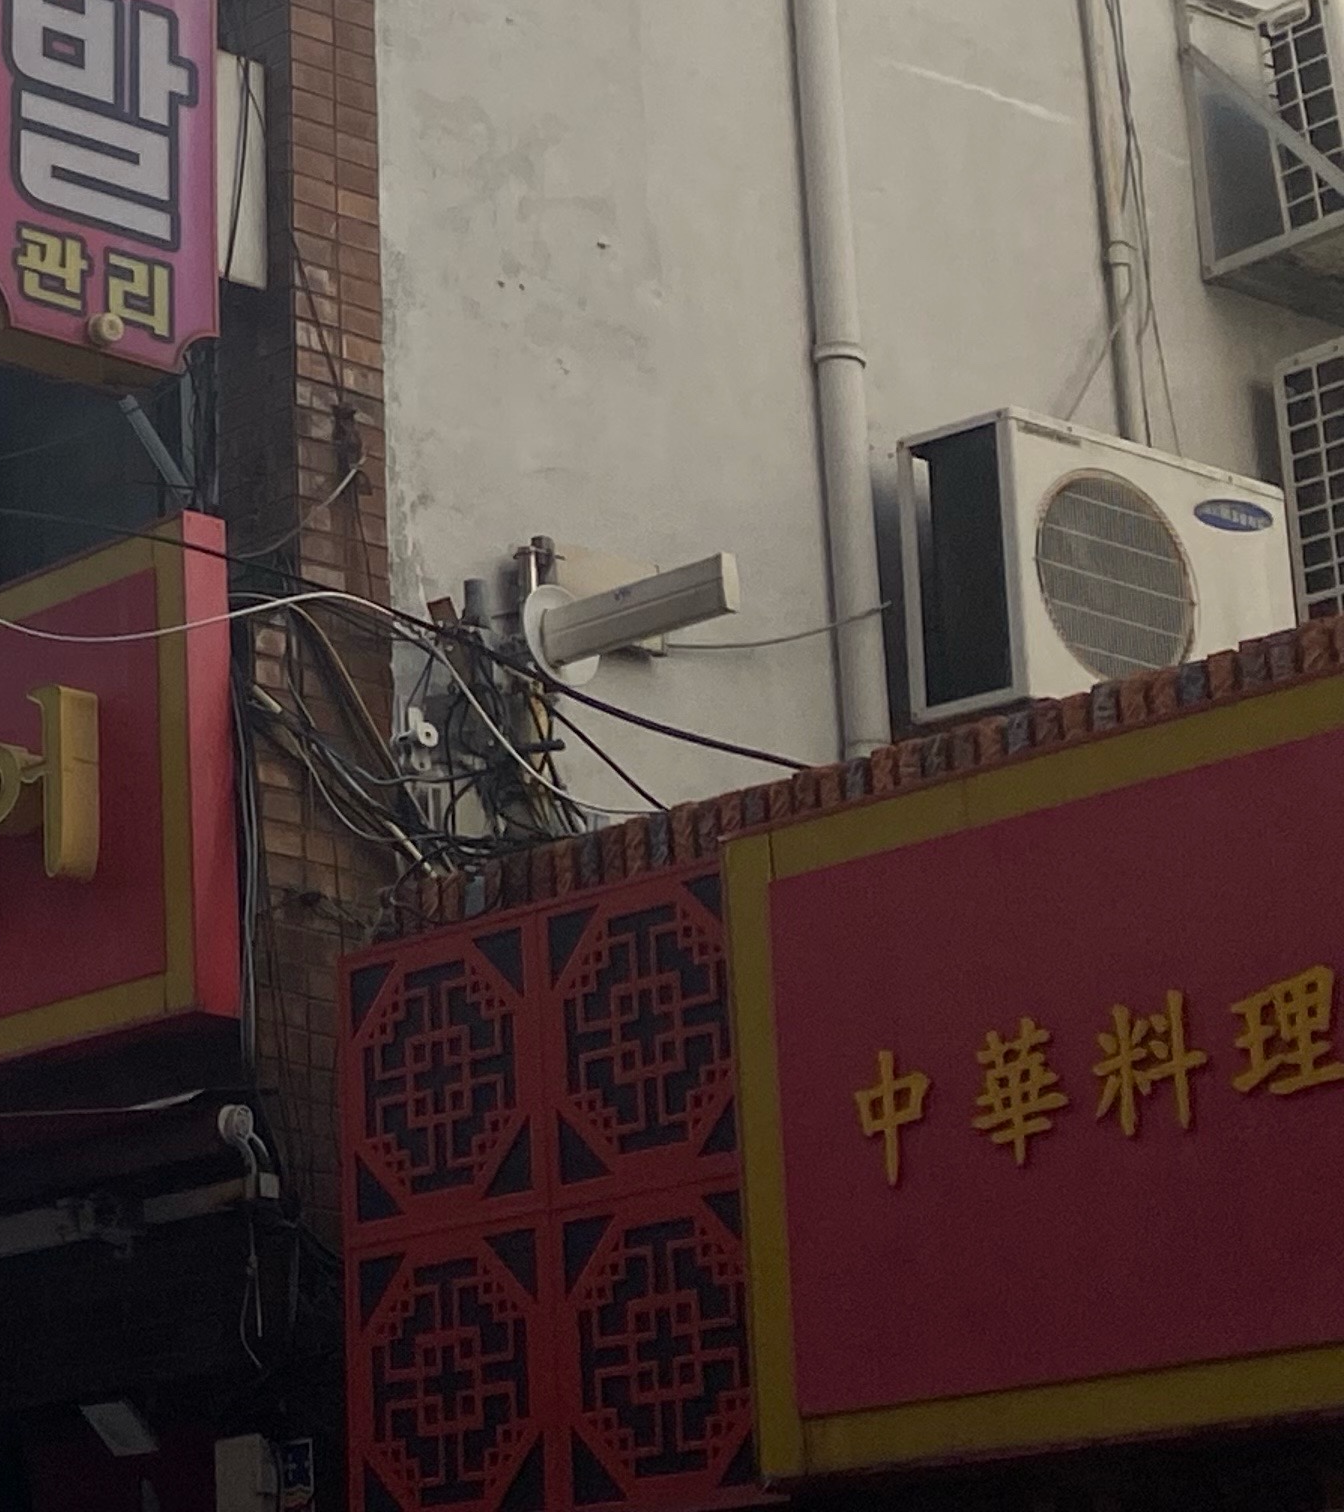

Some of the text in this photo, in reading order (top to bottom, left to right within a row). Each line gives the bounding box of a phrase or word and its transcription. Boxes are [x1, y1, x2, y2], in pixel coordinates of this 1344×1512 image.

[15, 222, 174, 343] 관리
[853, 964, 1344, 1188] 中華料理
